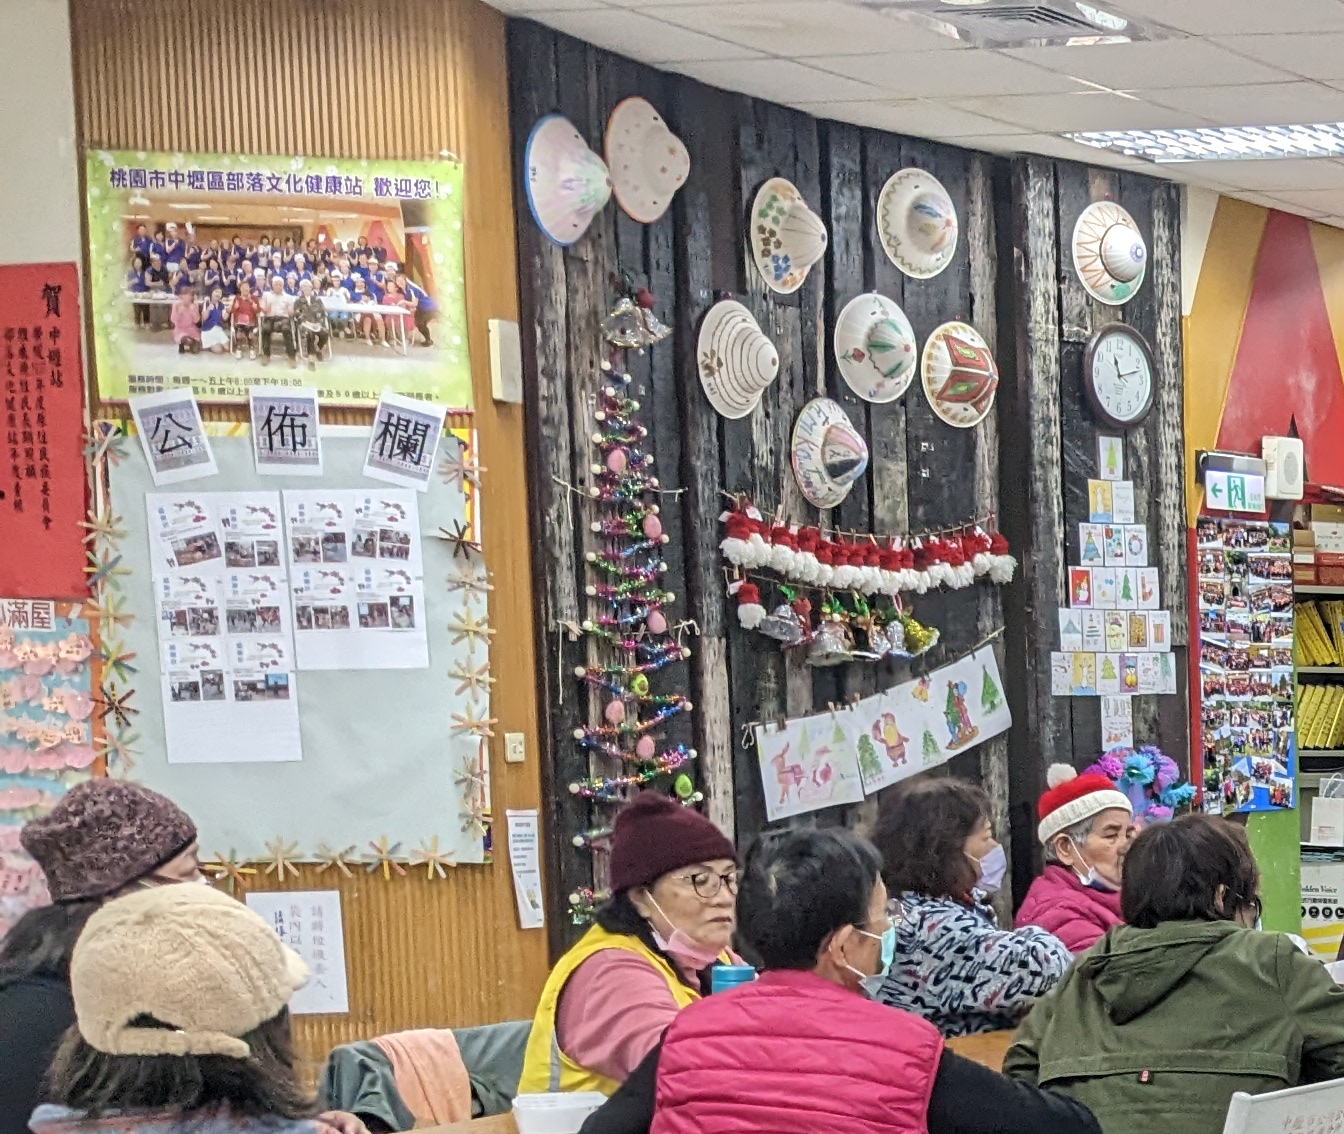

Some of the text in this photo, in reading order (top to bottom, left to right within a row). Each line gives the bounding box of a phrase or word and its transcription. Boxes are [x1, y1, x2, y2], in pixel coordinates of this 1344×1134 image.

[109, 167, 363, 196] 桃園市中壢區部落文化健康站
[42, 283, 62, 318] 賀
[151, 405, 431, 466] 公 佈 欄
[0, 600, 52, 630] 滿屋
